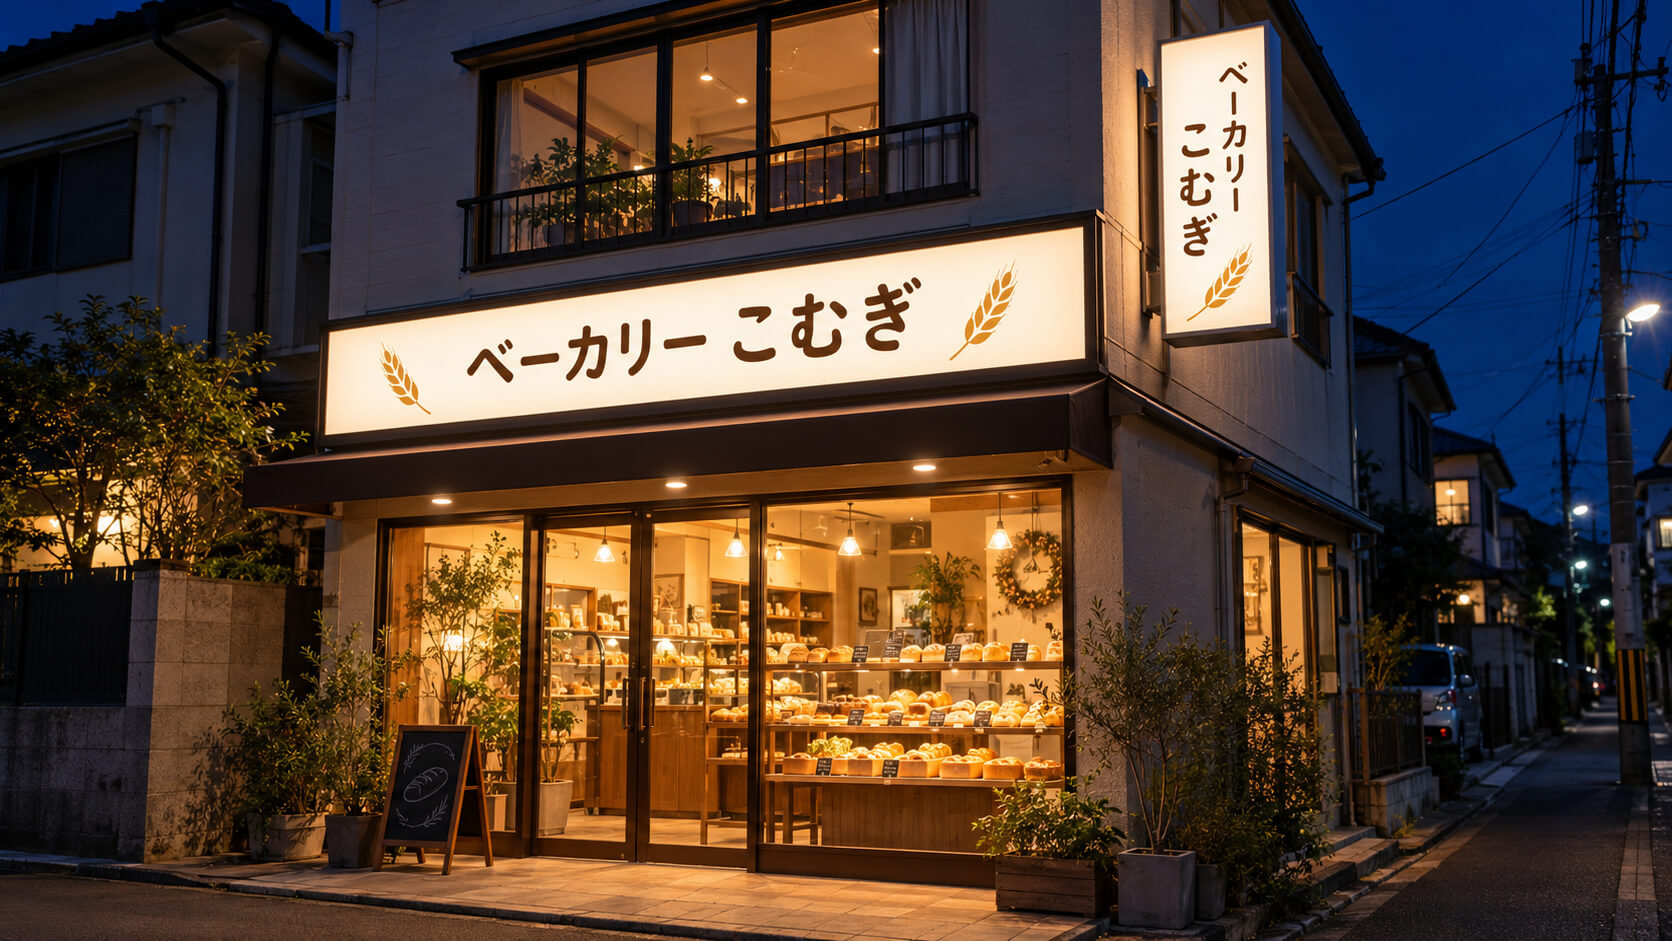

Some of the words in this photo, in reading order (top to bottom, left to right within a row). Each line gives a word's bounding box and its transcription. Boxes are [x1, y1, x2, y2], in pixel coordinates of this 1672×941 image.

[1179, 123, 1218, 257] こむぎ
[1218, 61, 1249, 212] ベーカリー
[466, 318, 707, 384] ベーカリー
[731, 276, 922, 364] こむぎ
